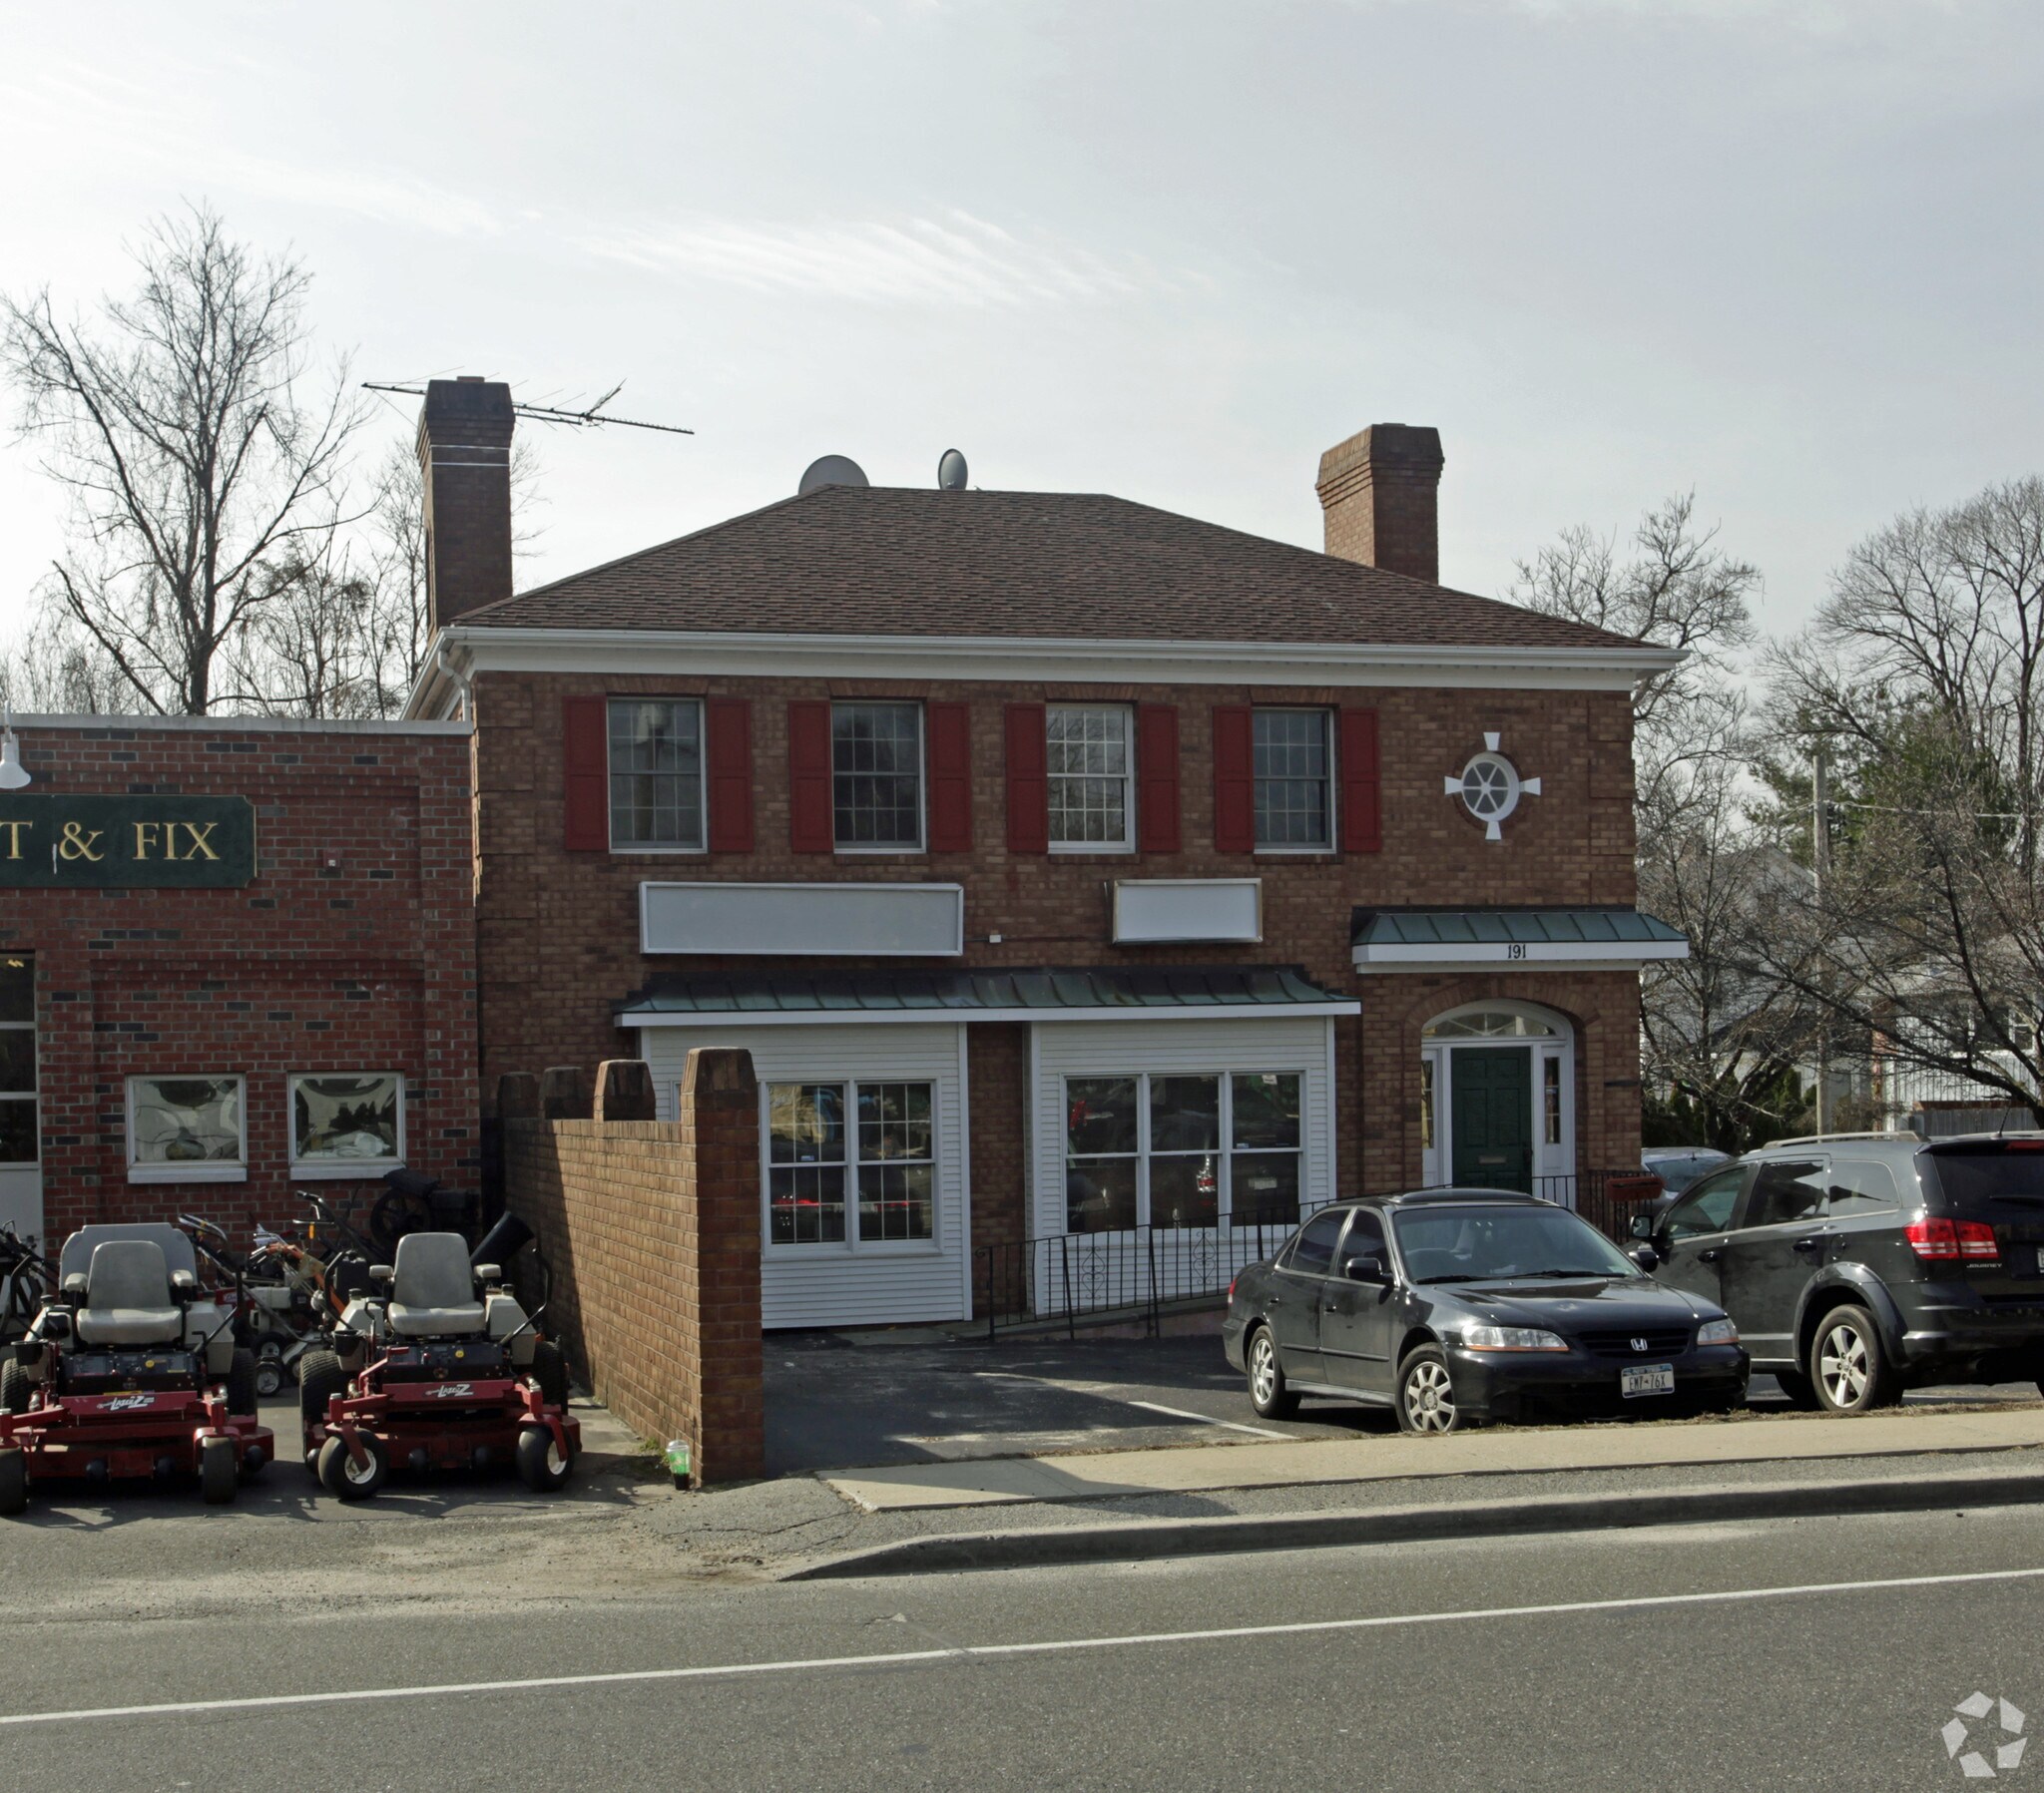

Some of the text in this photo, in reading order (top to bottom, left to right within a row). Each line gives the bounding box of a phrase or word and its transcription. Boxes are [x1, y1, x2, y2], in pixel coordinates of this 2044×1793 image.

[59, 821, 104, 861] &
[132, 822, 221, 860] FIX
[1508, 944, 1526, 959] 191
